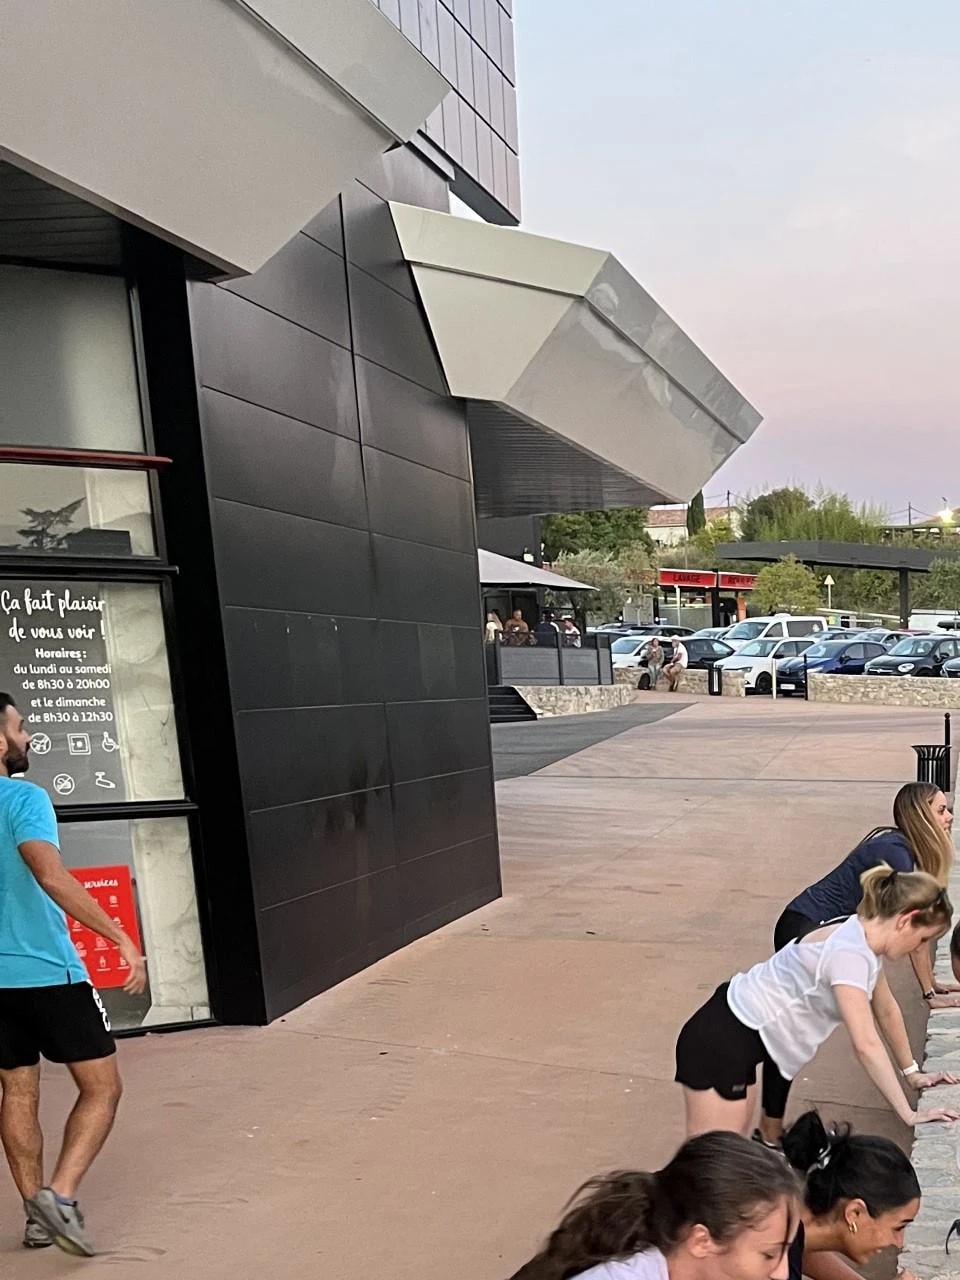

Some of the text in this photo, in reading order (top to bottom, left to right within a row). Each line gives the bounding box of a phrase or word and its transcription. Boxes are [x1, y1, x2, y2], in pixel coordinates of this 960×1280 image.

[0, 588, 106, 618] Ça fait plaisir
[8, 617, 27, 643] de
[30, 627, 64, 639] vous
[67, 624, 96, 640] voir
[13, 663, 112, 674] du lundi au samedi
[22, 678, 111, 689] de 8h30 à 20h00
[30, 697, 107, 707] et le dimanche
[28, 712, 114, 723] de 8h30 à 12h30
[83, 879, 119, 889] services
